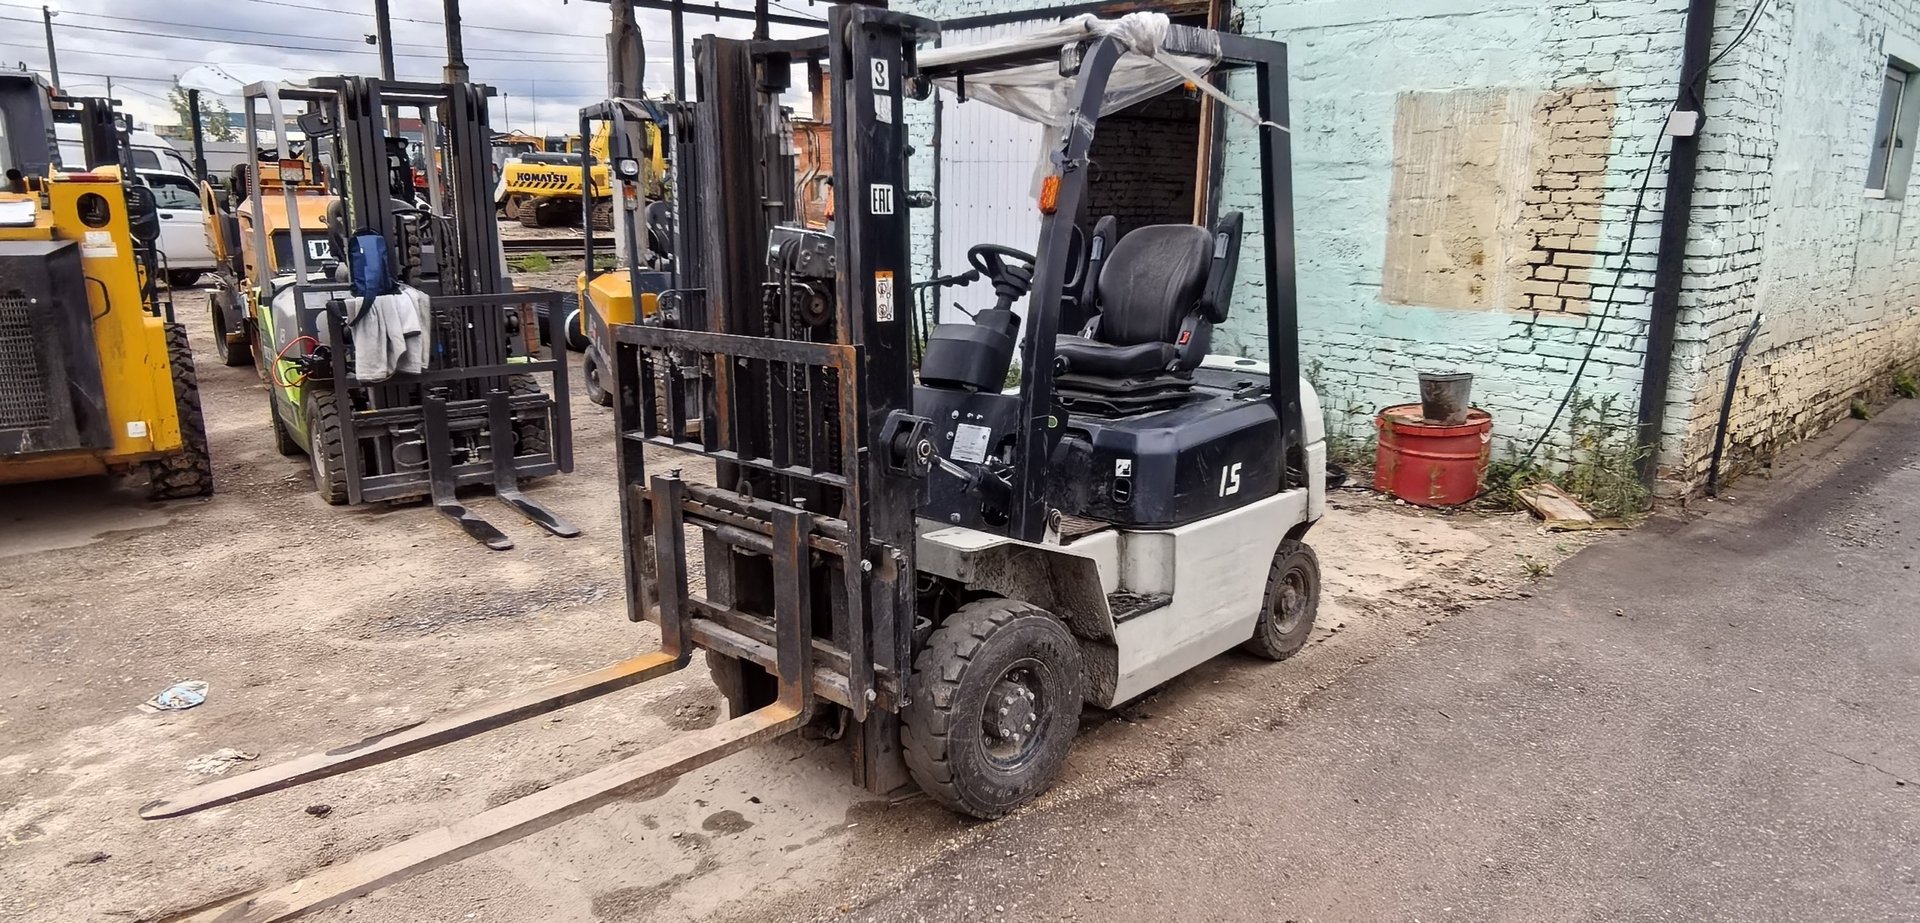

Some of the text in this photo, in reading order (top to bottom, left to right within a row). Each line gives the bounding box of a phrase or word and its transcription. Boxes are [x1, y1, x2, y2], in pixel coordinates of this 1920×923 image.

[517, 172, 568, 183] KOMATSU
[873, 188, 891, 213] EAC
[1219, 462, 1242, 497] 15
